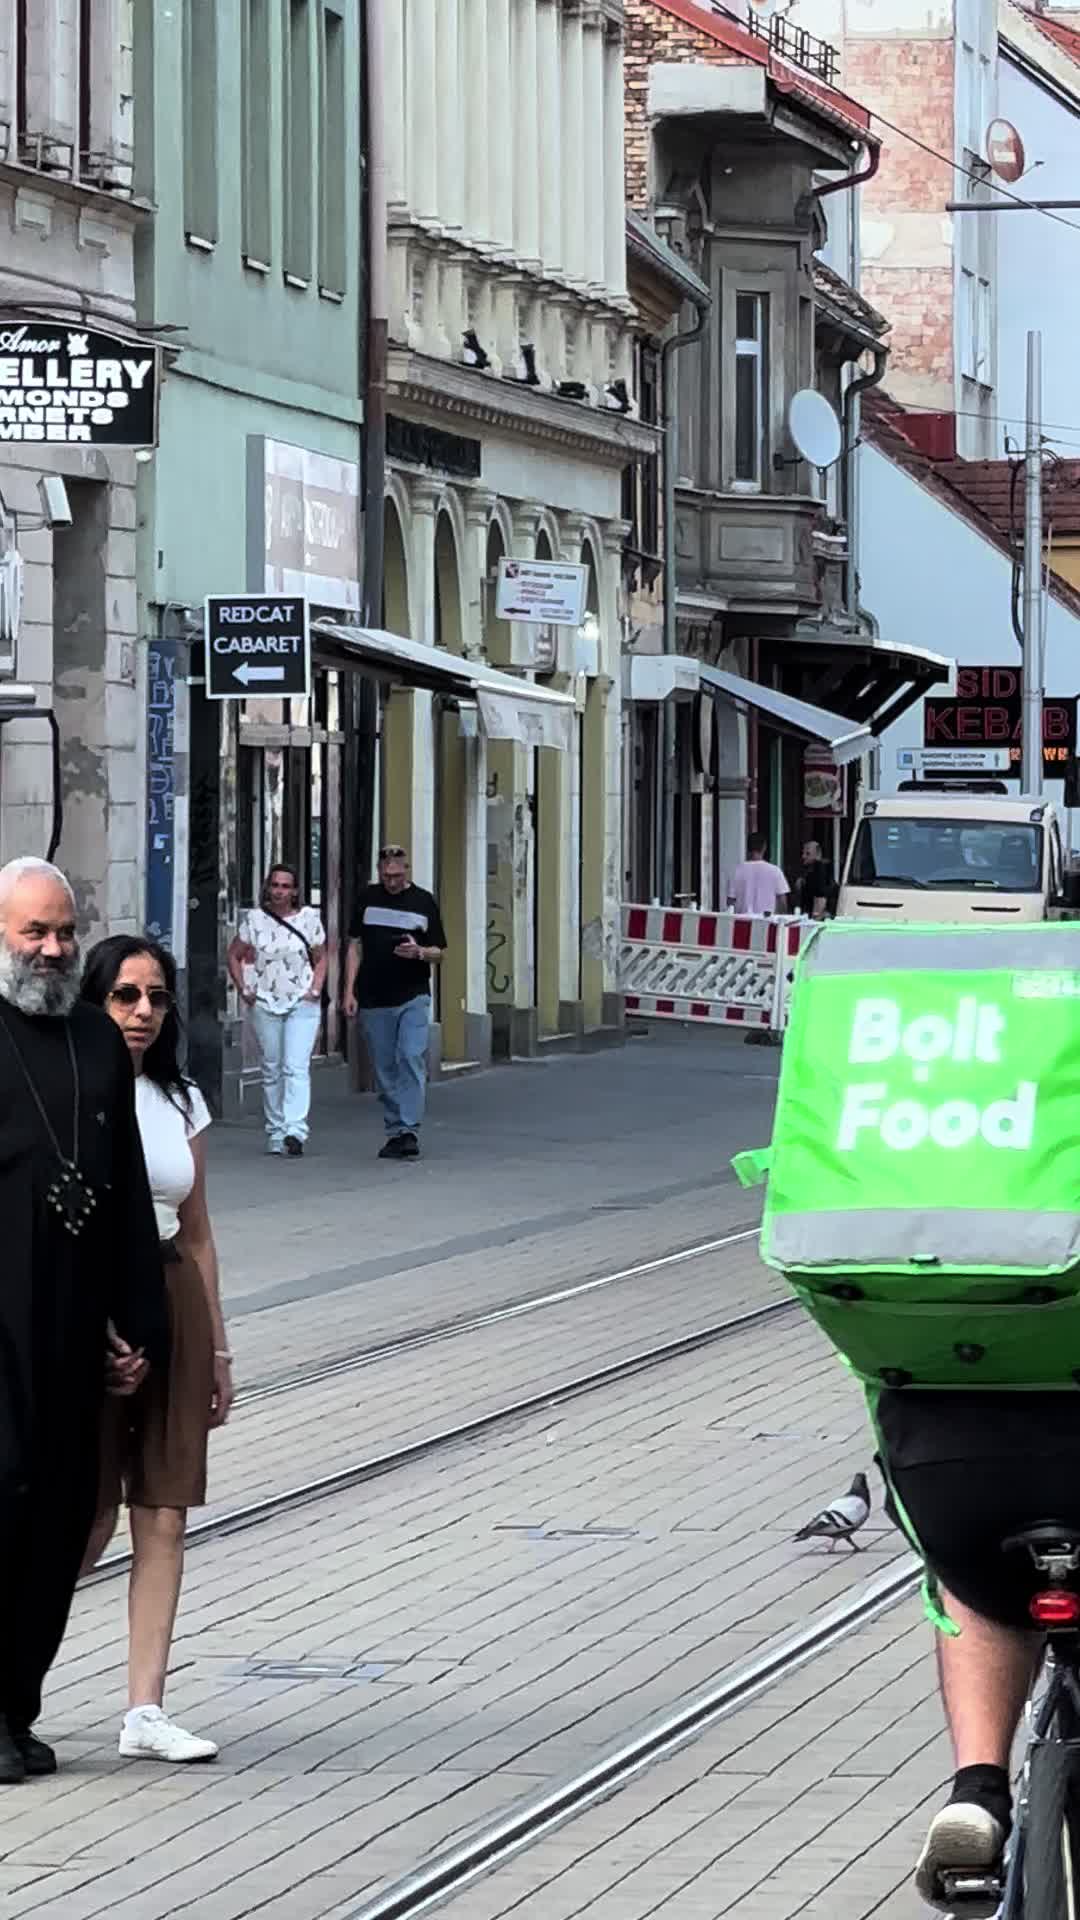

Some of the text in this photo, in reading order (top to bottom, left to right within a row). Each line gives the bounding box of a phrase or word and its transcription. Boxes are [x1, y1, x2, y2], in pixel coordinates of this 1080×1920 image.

[213, 636, 301, 653] CABARET
[848, 997, 1005, 1064] Bolt
[837, 1081, 1038, 1151] Food
